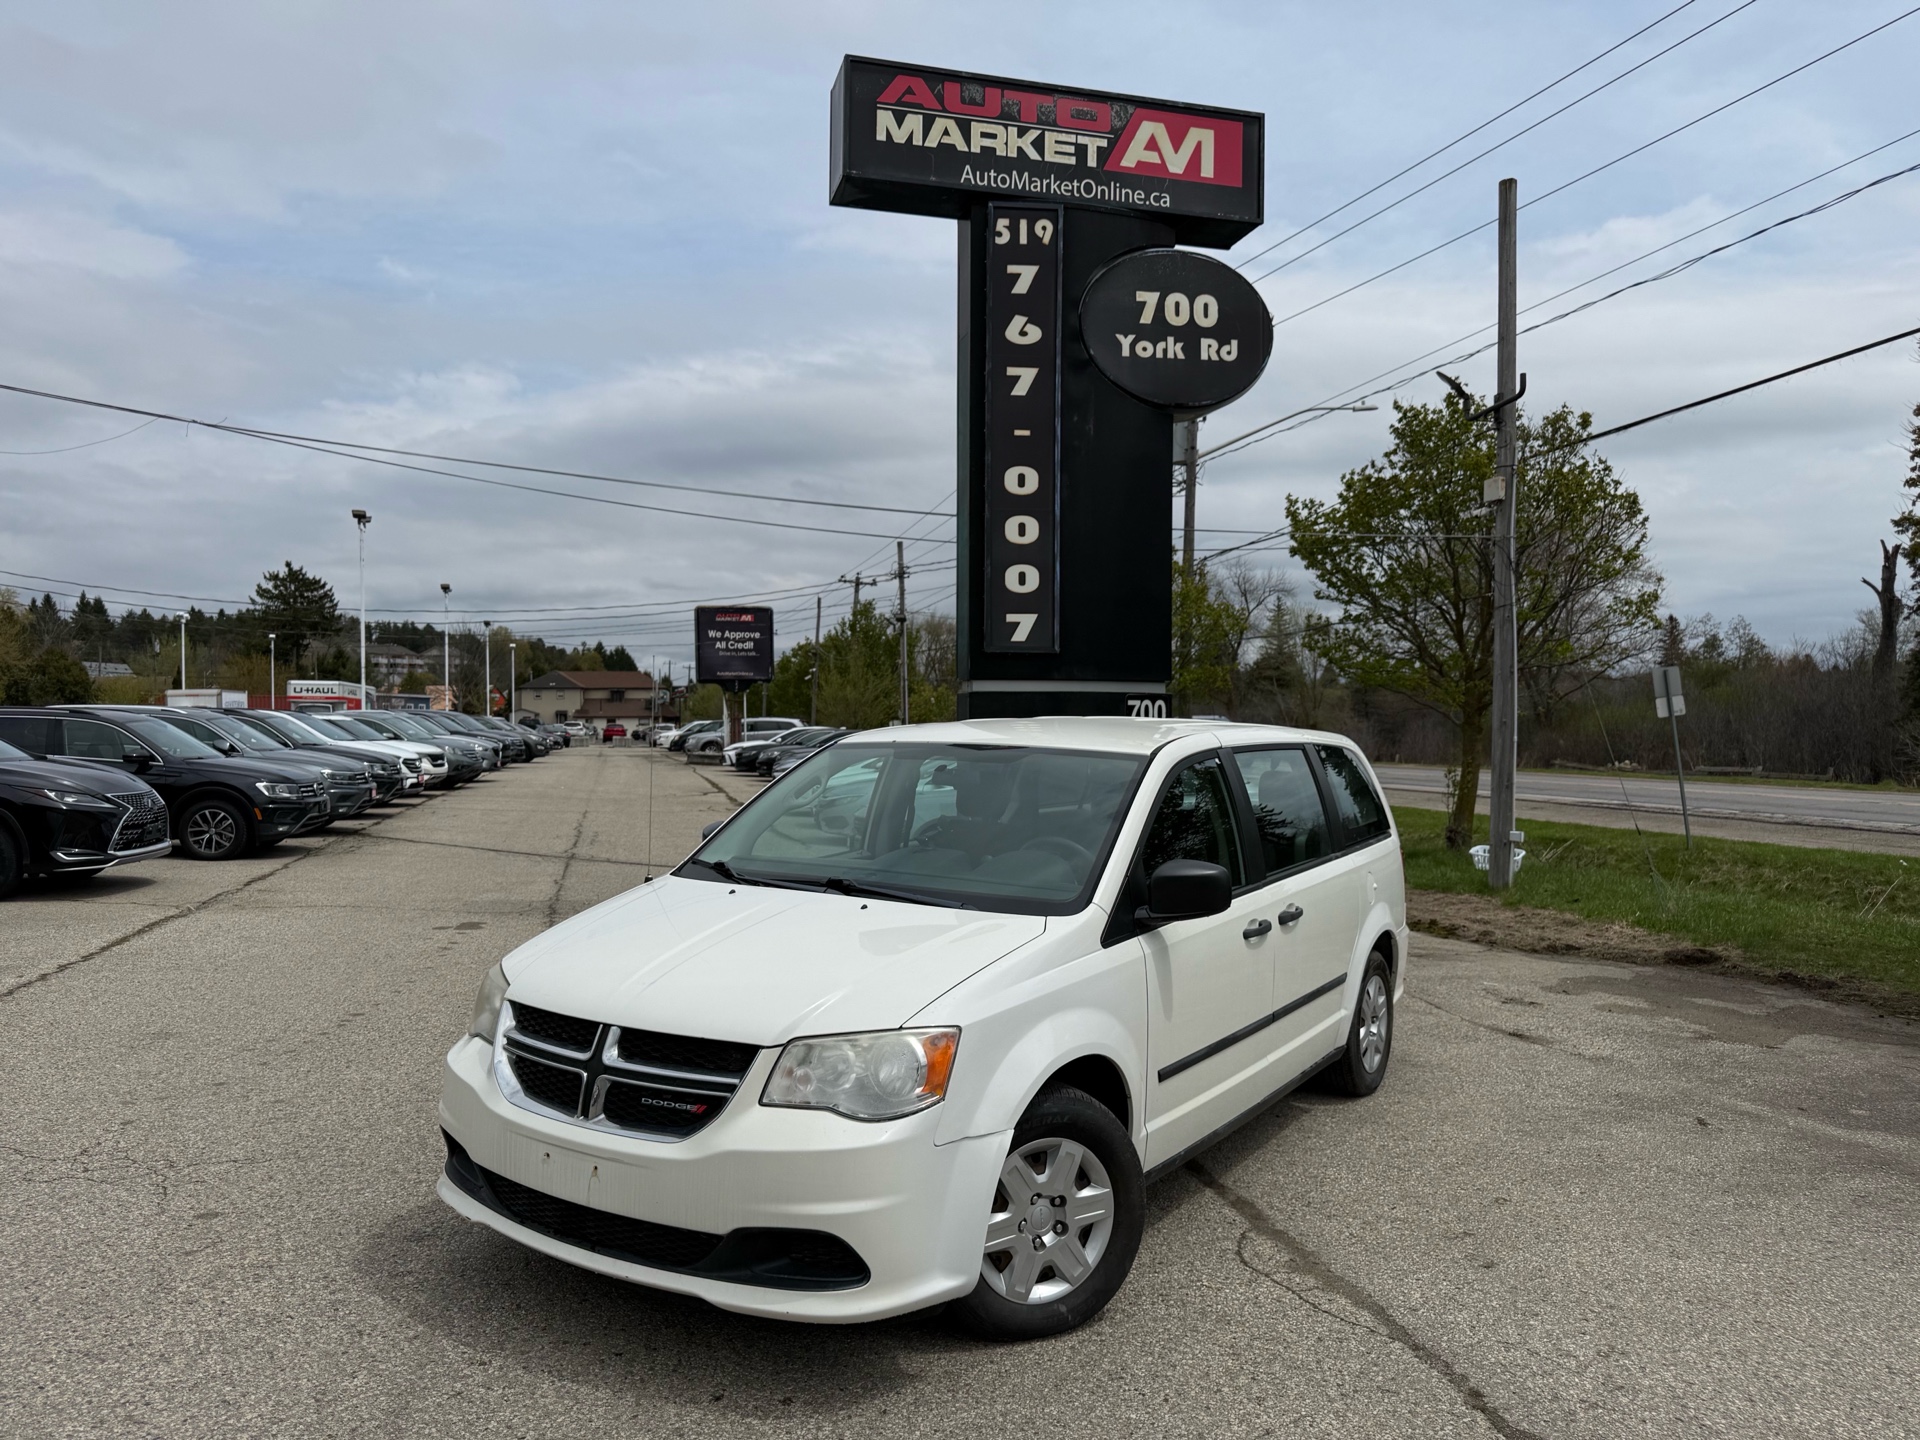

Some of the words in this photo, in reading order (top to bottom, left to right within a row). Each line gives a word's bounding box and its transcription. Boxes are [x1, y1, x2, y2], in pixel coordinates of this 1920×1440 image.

[876, 74, 1112, 133] AUTO
[876, 108, 1108, 168] MARKET
[1119, 120, 1215, 179] AM
[960, 164, 1171, 208] AutoMarketOnline.ca
[994, 217, 1054, 246] 519
[1135, 290, 1219, 328] 700
[1115, 333, 1185, 360] York
[1200, 338, 1238, 362] Rd
[708, 630, 722, 638] We
[724, 630, 760, 640] Approve
[715, 641, 726, 649] All
[728, 641, 754, 649] Credit
[293, 686, 337, 694] U-HAUL
[1127, 699, 1167, 718] 700
[641, 1097, 697, 1111] DODGE
